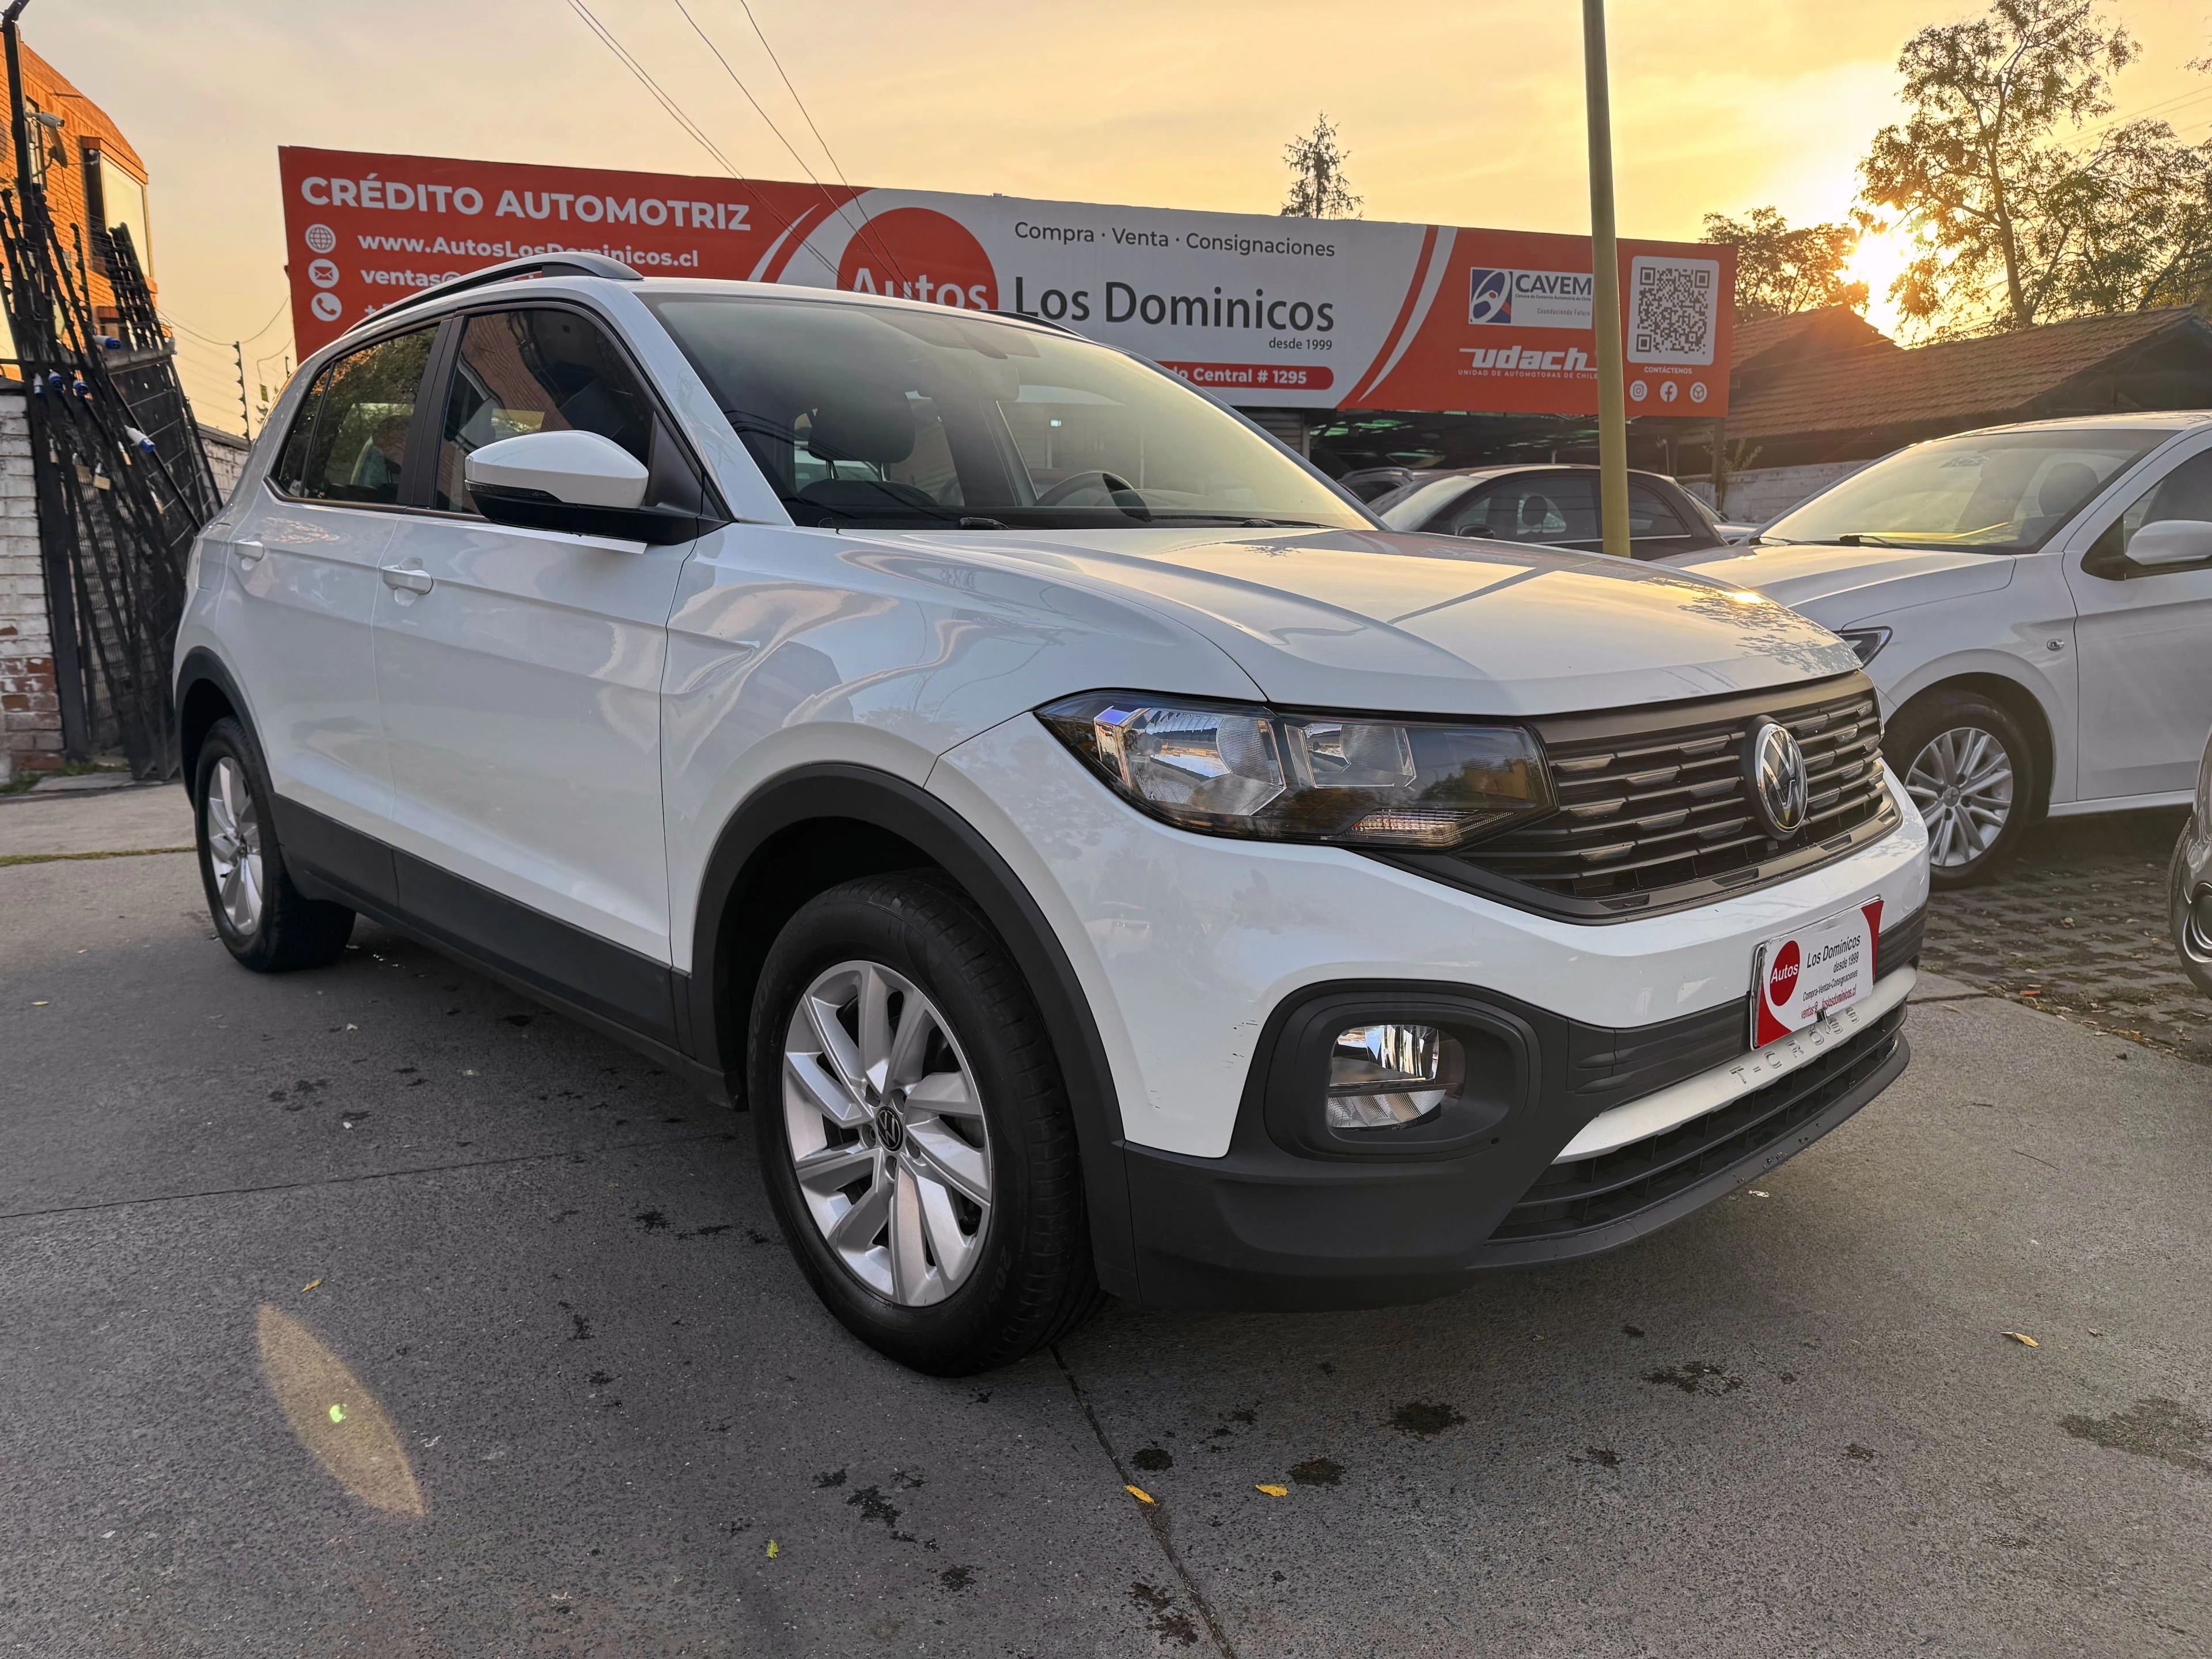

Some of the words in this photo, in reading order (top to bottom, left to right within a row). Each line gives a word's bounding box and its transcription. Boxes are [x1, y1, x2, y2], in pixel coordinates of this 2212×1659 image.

[301, 173, 484, 215] CRÉDITO
[495, 190, 751, 231] AUTOMOTRIZ
[1015, 221, 1094, 245] Compra
[1112, 228, 1169, 247] Venta
[1185, 232, 1335, 257] Consignaciones
[1515, 274, 1592, 296] CAVEM
[1015, 276, 1090, 321] Los
[1105, 281, 1334, 332] Dominicos
[1268, 337, 1302, 349] desde
[1306, 339, 1332, 350] 1999
[1193, 367, 1253, 382] Central
[1257, 370, 1268, 382] #
[1272, 370, 1307, 384] 1295
[1643, 366, 1692, 374] CONTÁCTENOS
[1806, 952, 1821, 968] Los
[1823, 935, 1861, 961] Dominicos
[1834, 957, 1847, 973] desde
[1848, 952, 1859, 966] 1999
[1770, 964, 1798, 984] Autos
